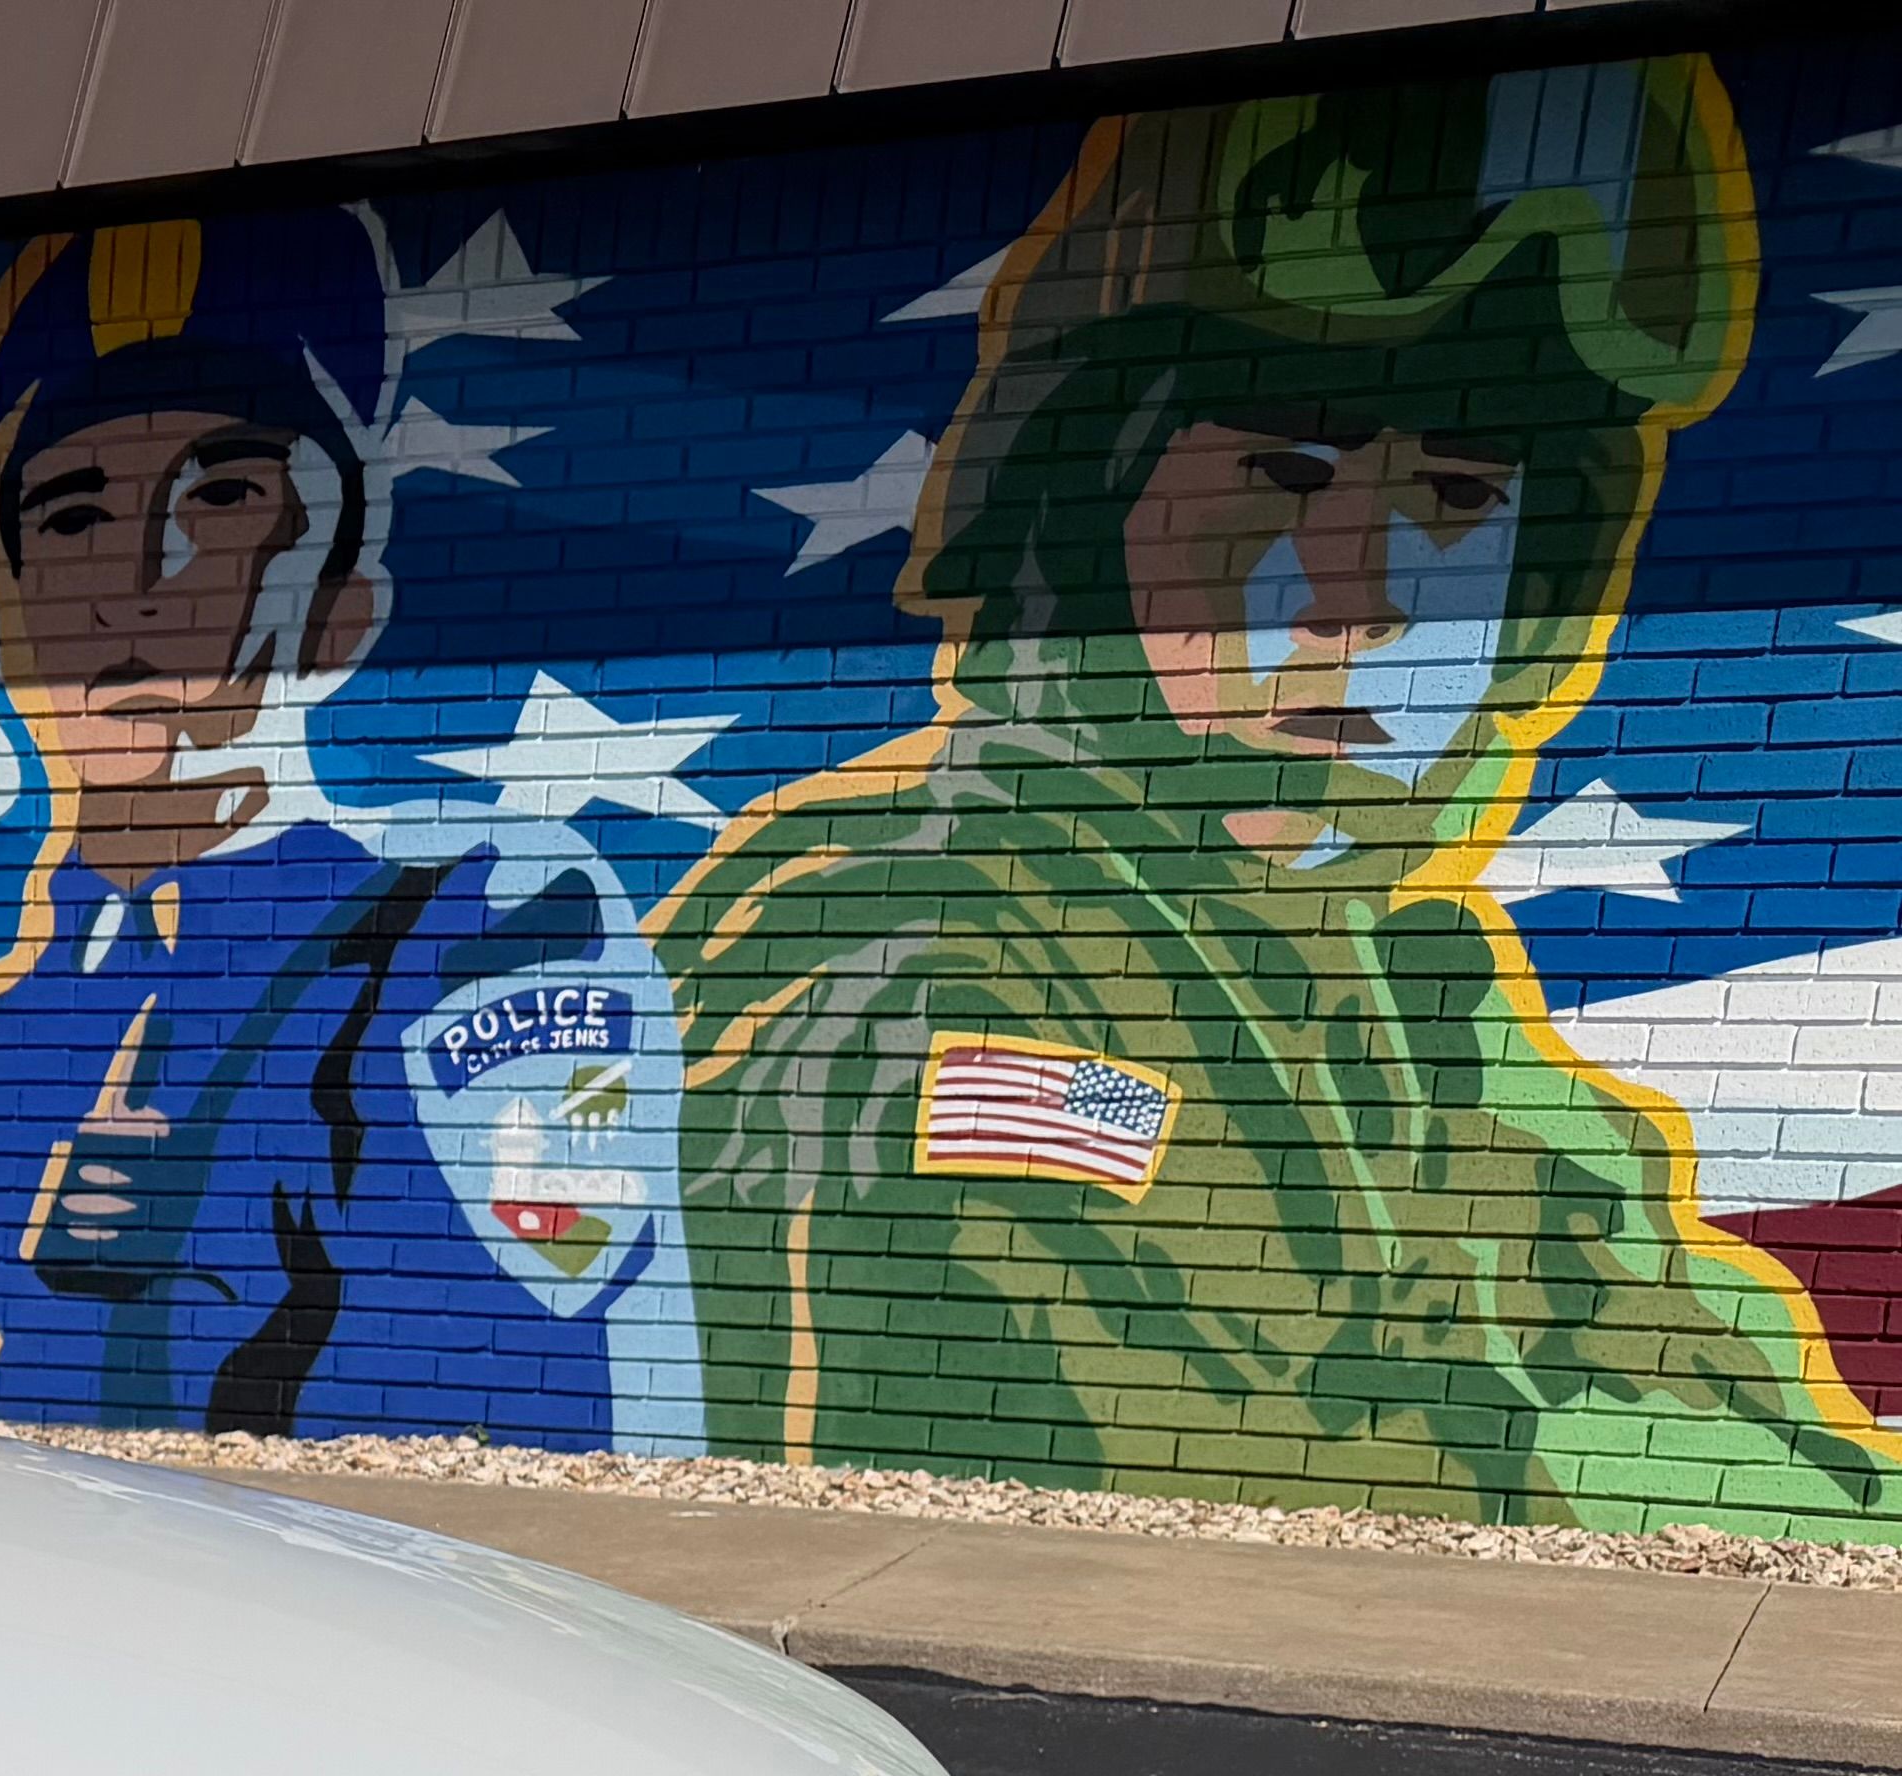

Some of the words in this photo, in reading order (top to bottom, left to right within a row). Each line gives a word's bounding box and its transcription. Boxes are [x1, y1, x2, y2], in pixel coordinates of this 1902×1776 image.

[443, 988, 610, 1066] POLICE
[466, 1037, 512, 1075] CITY
[548, 1027, 610, 1050] JENKS
